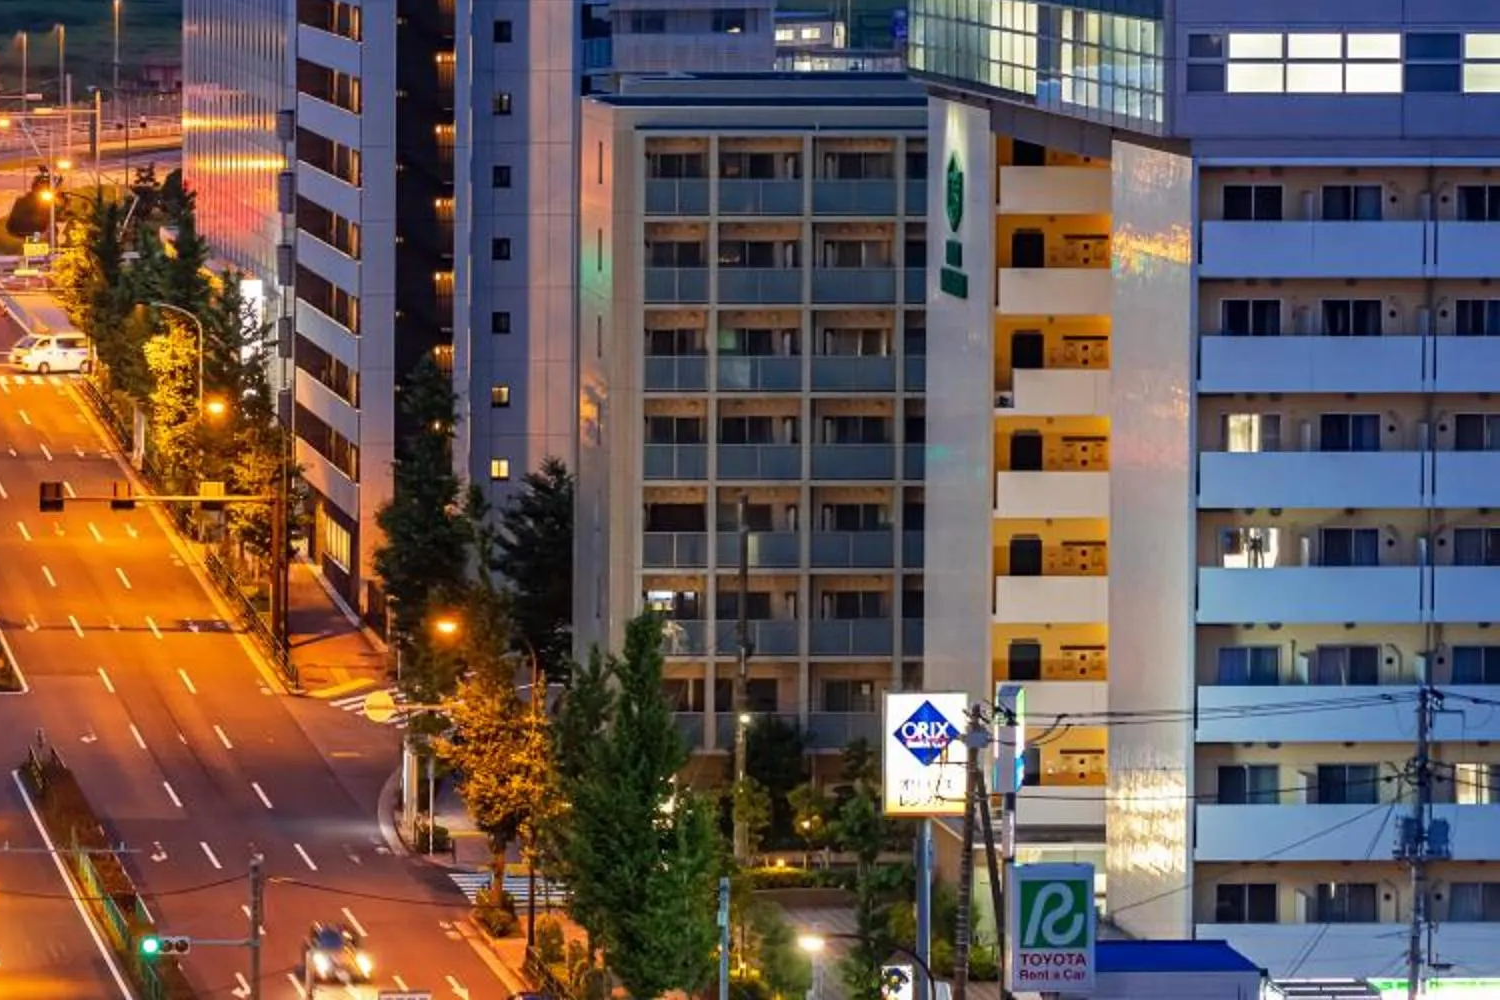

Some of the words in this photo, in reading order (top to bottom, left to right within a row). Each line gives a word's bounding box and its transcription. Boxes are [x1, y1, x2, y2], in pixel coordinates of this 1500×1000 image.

[902, 721, 949, 740] ORIX
[1020, 953, 1087, 967] TOYOTA
[1020, 969, 1049, 981] Rent
[1063, 969, 1086, 981] Car
